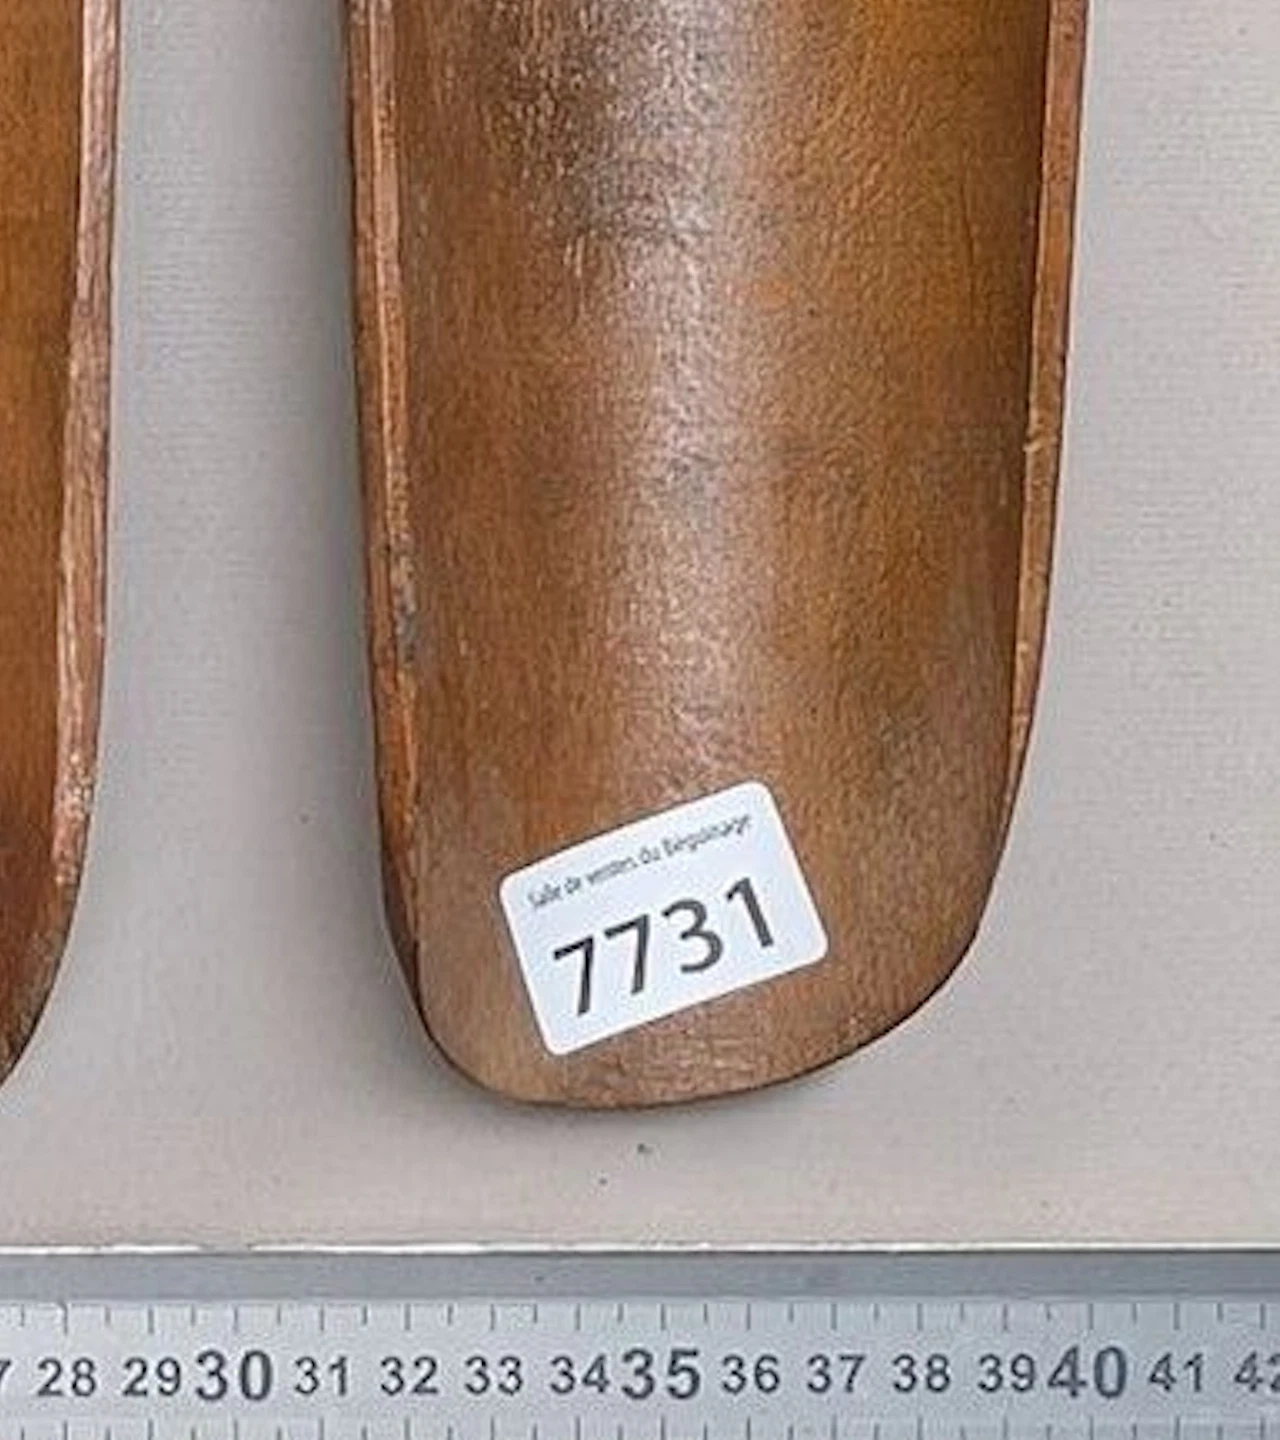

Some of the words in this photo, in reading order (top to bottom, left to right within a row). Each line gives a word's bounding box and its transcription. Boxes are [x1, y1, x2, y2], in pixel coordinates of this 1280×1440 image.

[564, 874, 582, 895] de
[552, 877, 774, 1016] 7731
[37, 1357, 97, 1398] 28
[122, 1357, 181, 1397] 29
[195, 1349, 273, 1403] 30
[294, 1356, 347, 1397] 31
[381, 1356, 439, 1397] 32
[464, 1355, 523, 1396] 33
[550, 1354, 610, 1395] 34
[621, 1348, 700, 1400] 35
[722, 1354, 780, 1396] 36
[807, 1354, 866, 1394] 37
[892, 1354, 951, 1394] 38
[978, 1353, 1036, 1393] 39
[1047, 1345, 1127, 1400] 40
[1148, 1353, 1202, 1392] 41
